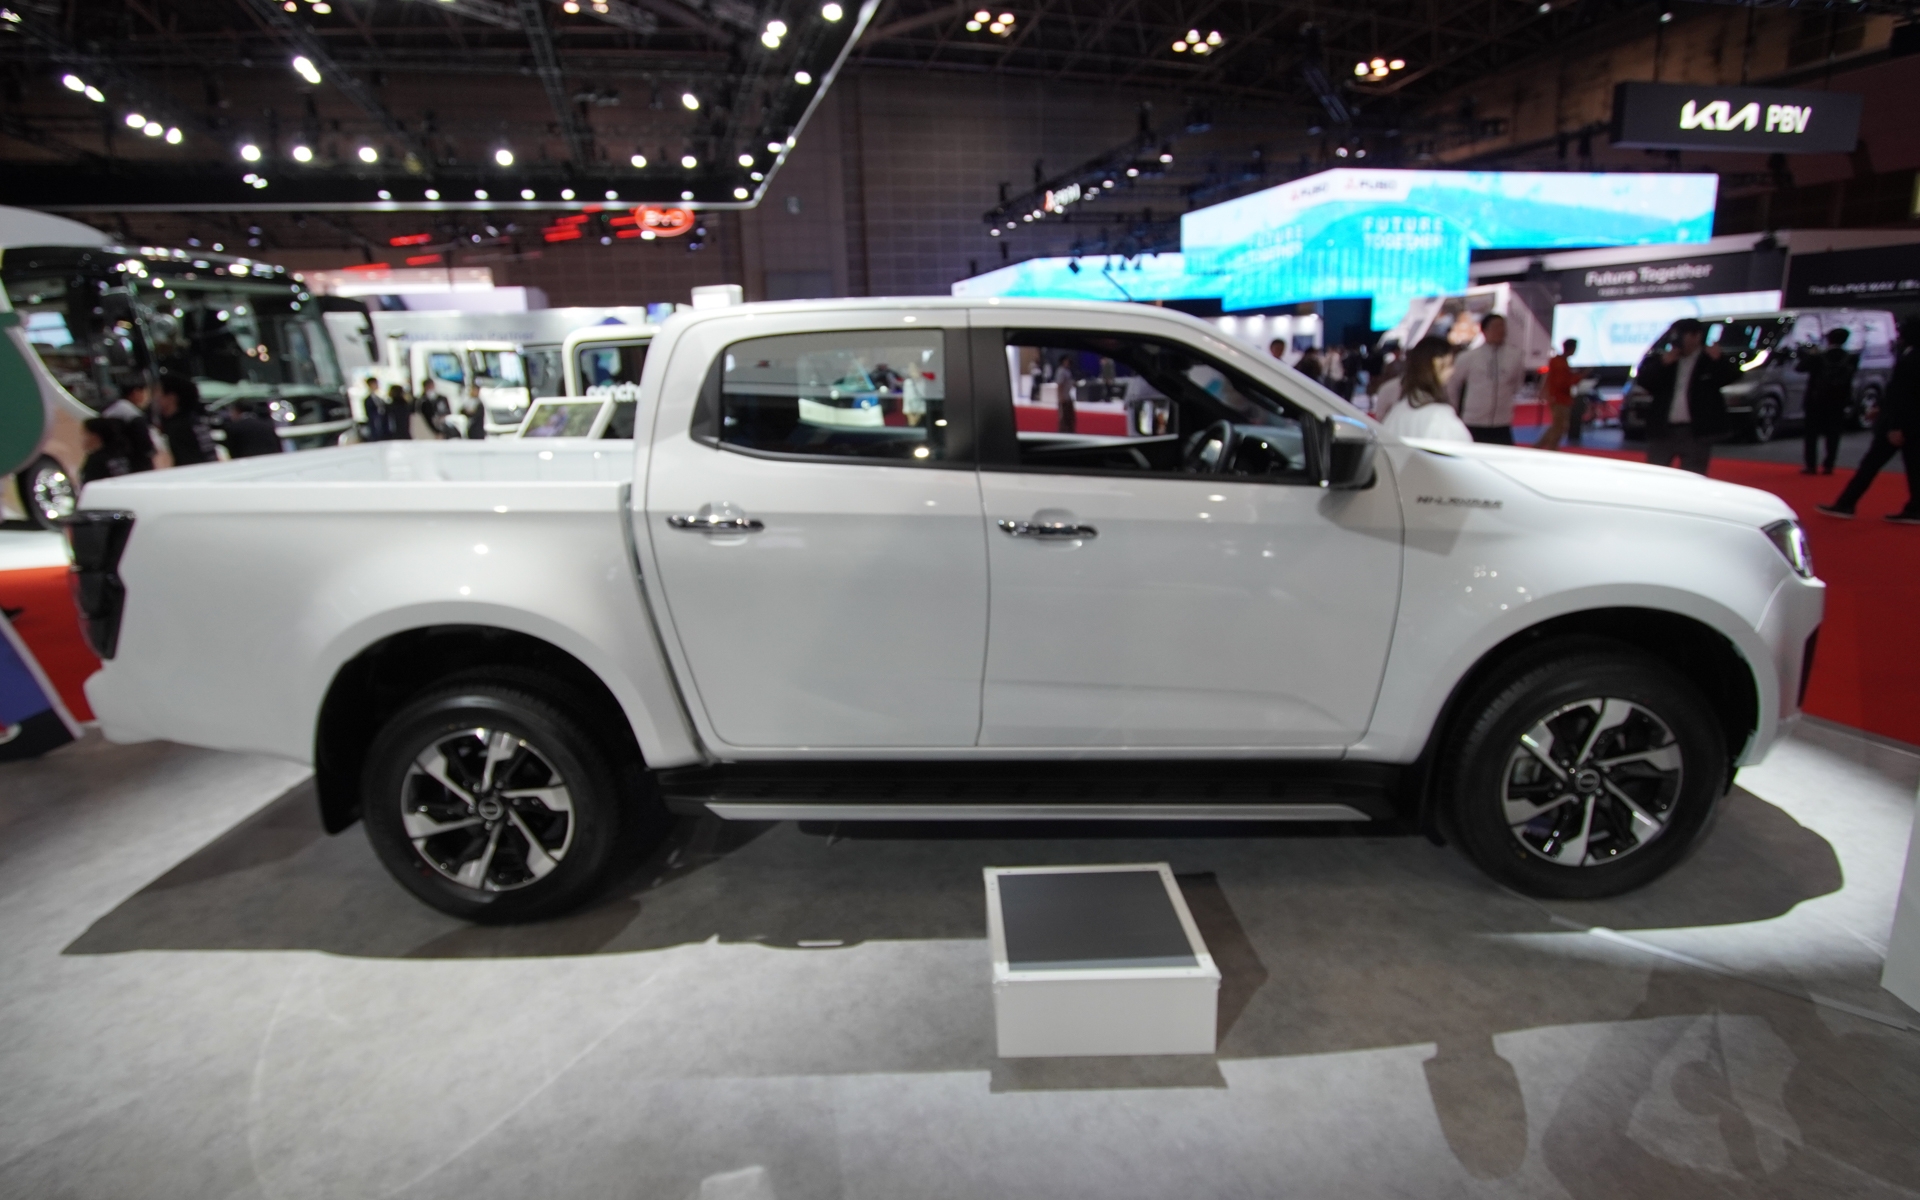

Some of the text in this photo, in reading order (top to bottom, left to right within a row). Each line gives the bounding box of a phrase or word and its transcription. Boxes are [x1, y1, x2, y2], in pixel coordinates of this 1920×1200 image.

[1680, 100, 1812, 133] KIA PBV
[1363, 216, 1444, 233] FUTURE
[1585, 263, 1713, 287] Future Together
